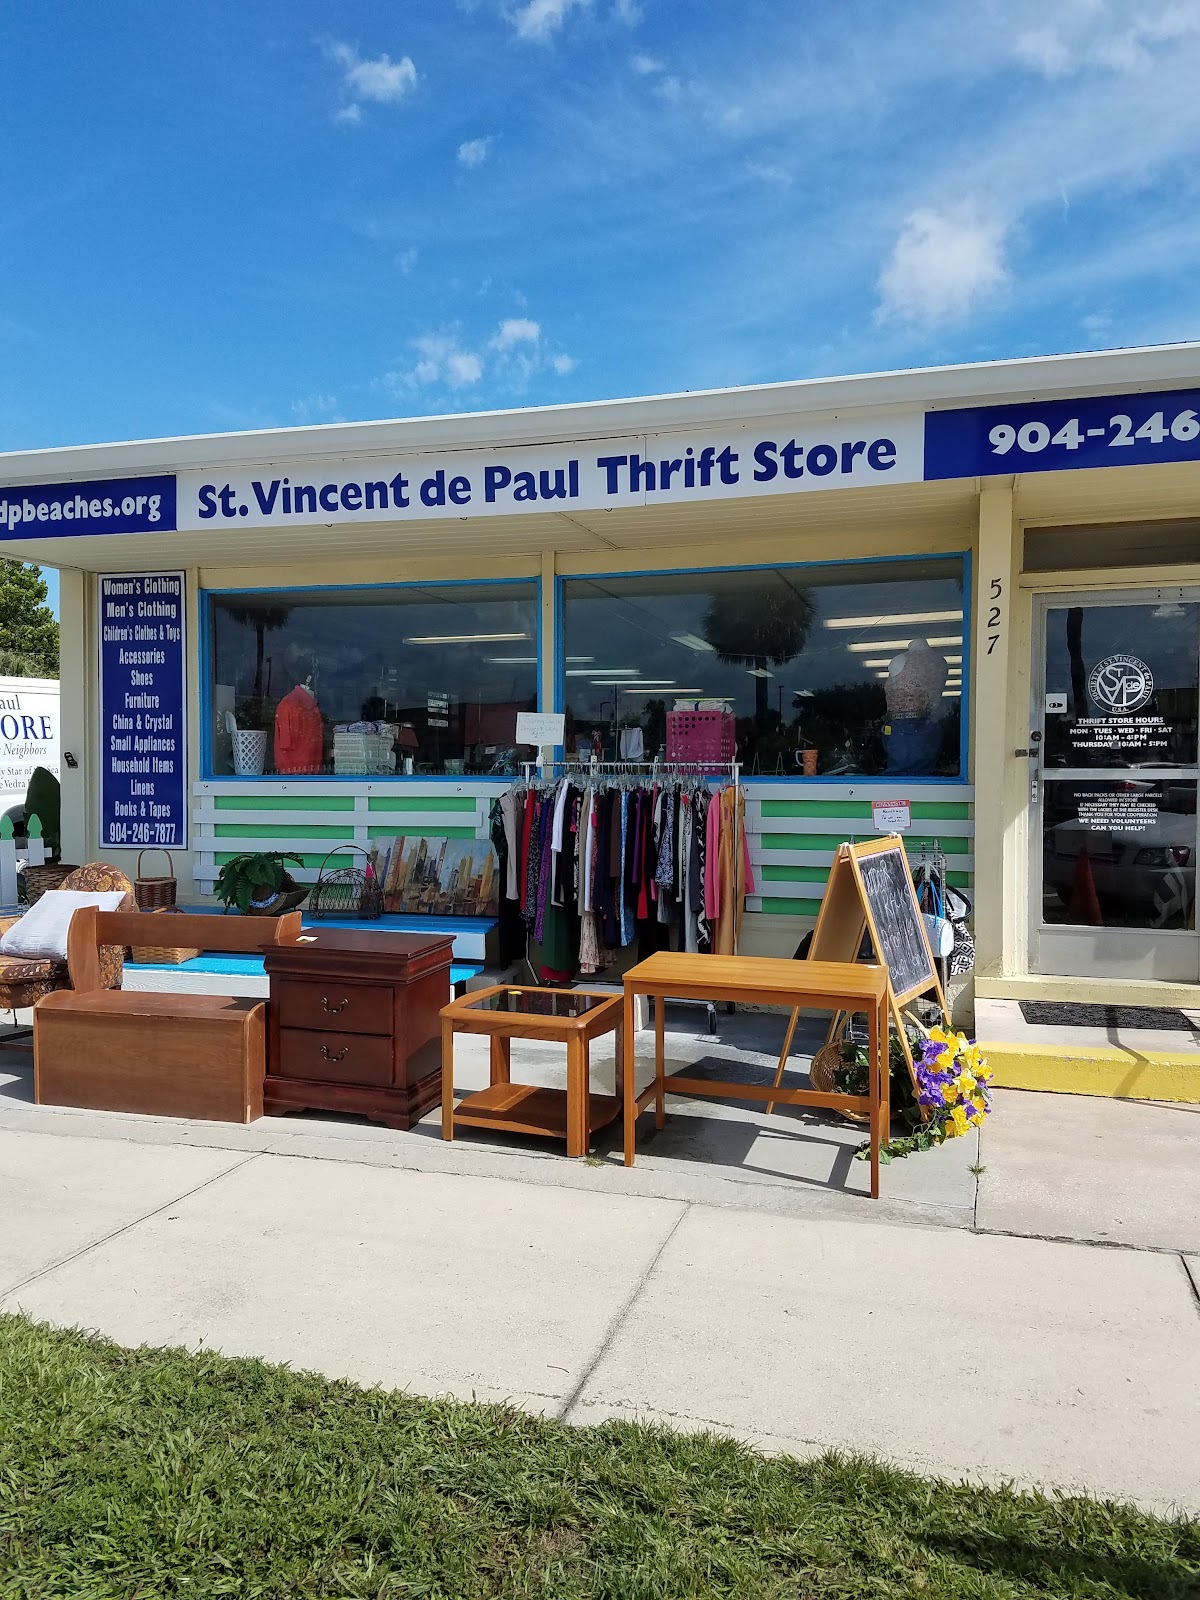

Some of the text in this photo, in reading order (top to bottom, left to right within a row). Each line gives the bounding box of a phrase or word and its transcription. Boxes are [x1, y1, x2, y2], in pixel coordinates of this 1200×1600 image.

[988, 409, 1200, 455] 904-246
[420, 470, 472, 506] de
[484, 460, 579, 503] Paul
[597, 446, 739, 495] Thrift
[753, 438, 897, 481] Store
[0, 494, 162, 531] dpbeaches.org
[104, 578, 180, 596] Women's Clothing
[106, 601, 176, 619] Men's Clothing
[104, 624, 180, 642] Children's Clothes & Toys
[119, 648, 165, 664] Accessories
[131, 670, 153, 686] Shoes
[1140, 680, 1152, 699] PAUL
[125, 692, 160, 708] Furniture
[0, 714, 54, 740] ORE
[112, 714, 172, 732] China & Crystal
[3, 742, 47, 760] Neighbors
[110, 736, 175, 753] Small Appliances
[7, 766, 22, 776] Star
[24, 766, 32, 774] of
[112, 757, 174, 773] Household Items
[4, 779, 26, 788] Vedra
[130, 779, 154, 796] Linens
[114, 801, 170, 819] Books & Tapes
[110, 822, 176, 843] 904-246-7877
